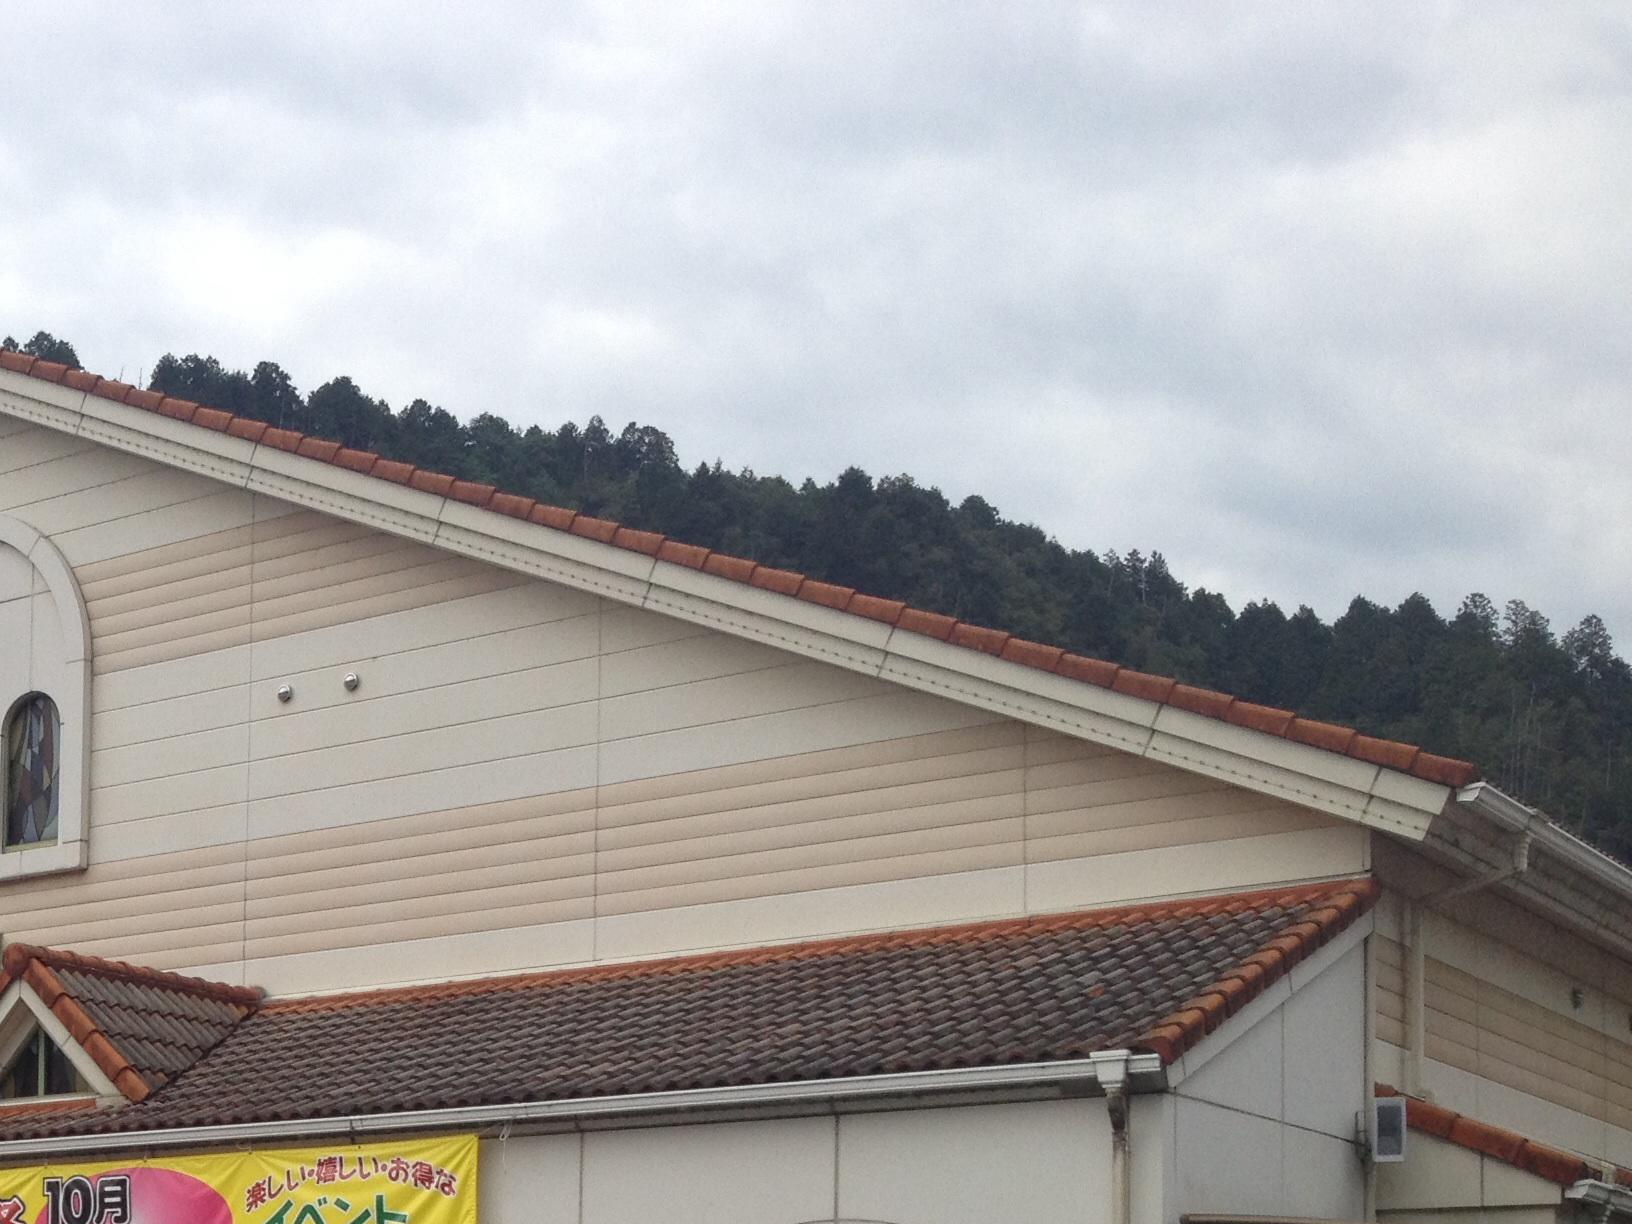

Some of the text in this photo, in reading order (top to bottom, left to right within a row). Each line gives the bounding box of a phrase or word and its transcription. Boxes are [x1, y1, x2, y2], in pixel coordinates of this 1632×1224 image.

[244, 1154, 458, 1212] 楽しい・嬉しい・お得な
